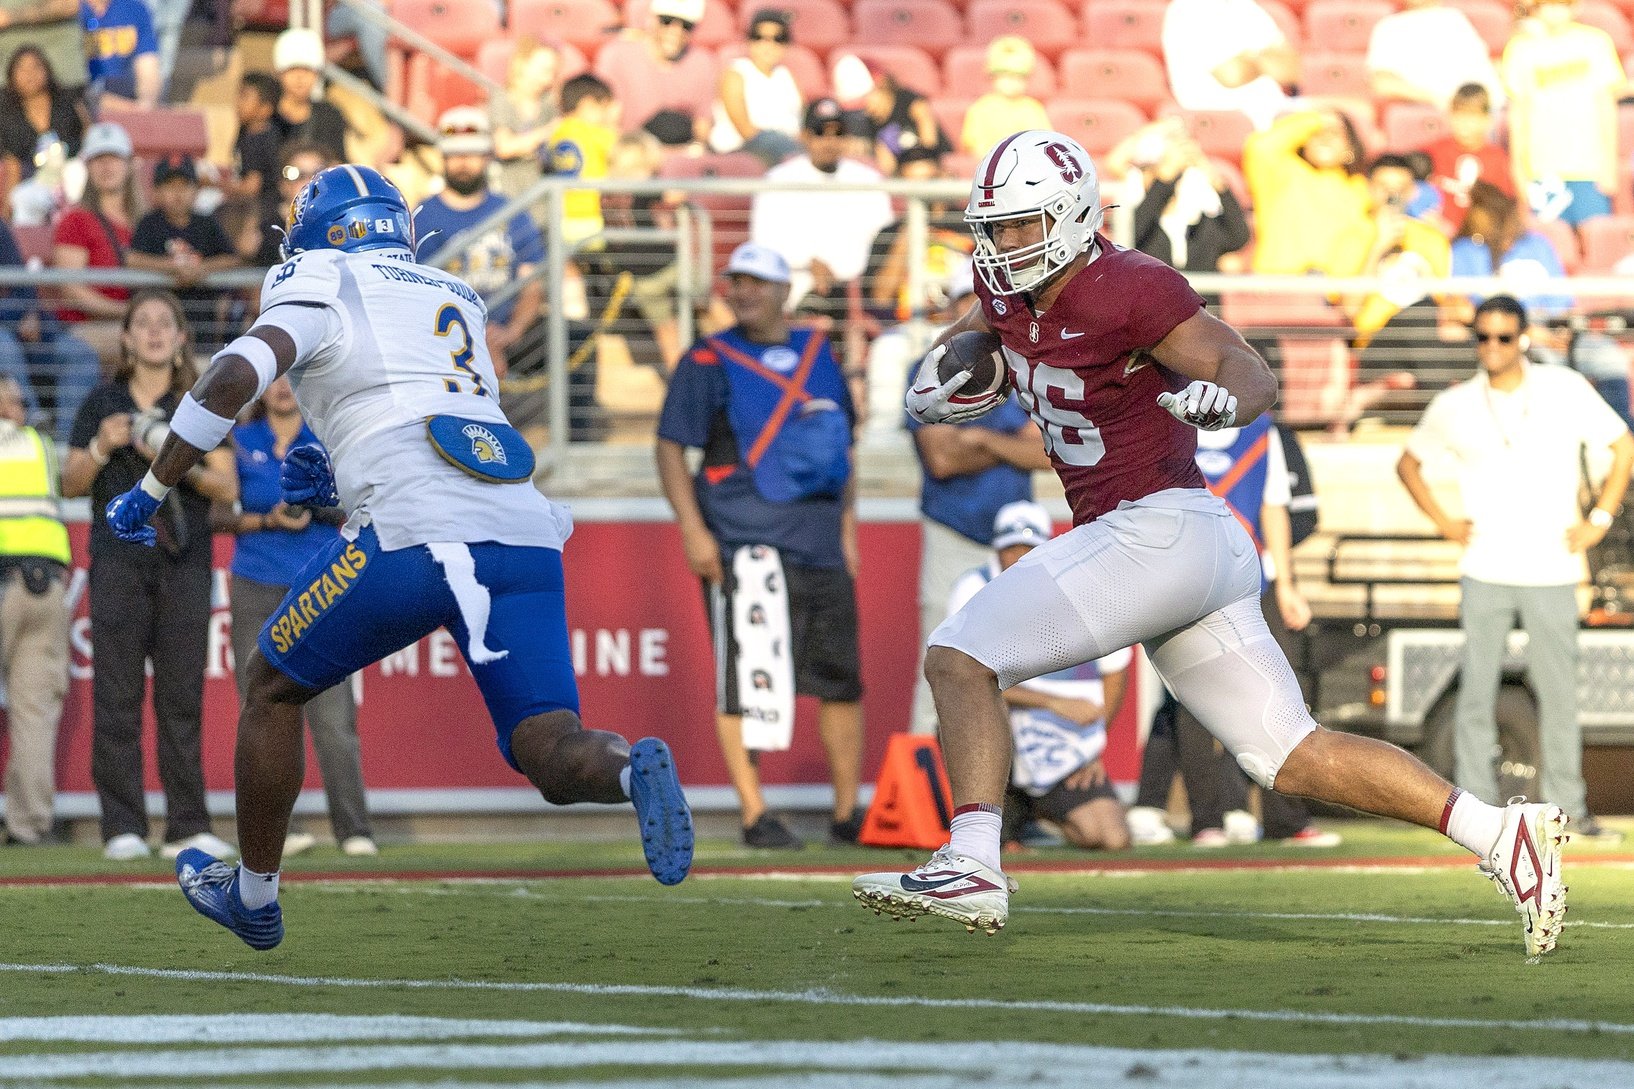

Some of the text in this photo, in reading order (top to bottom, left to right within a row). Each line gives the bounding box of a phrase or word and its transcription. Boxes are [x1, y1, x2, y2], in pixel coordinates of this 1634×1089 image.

[330, 229, 343, 241] 89
[381, 220, 388, 231] 3
[434, 303, 487, 397] 3
[271, 543, 367, 653] SPARTANS
[379, 628, 670, 677] MEINE
